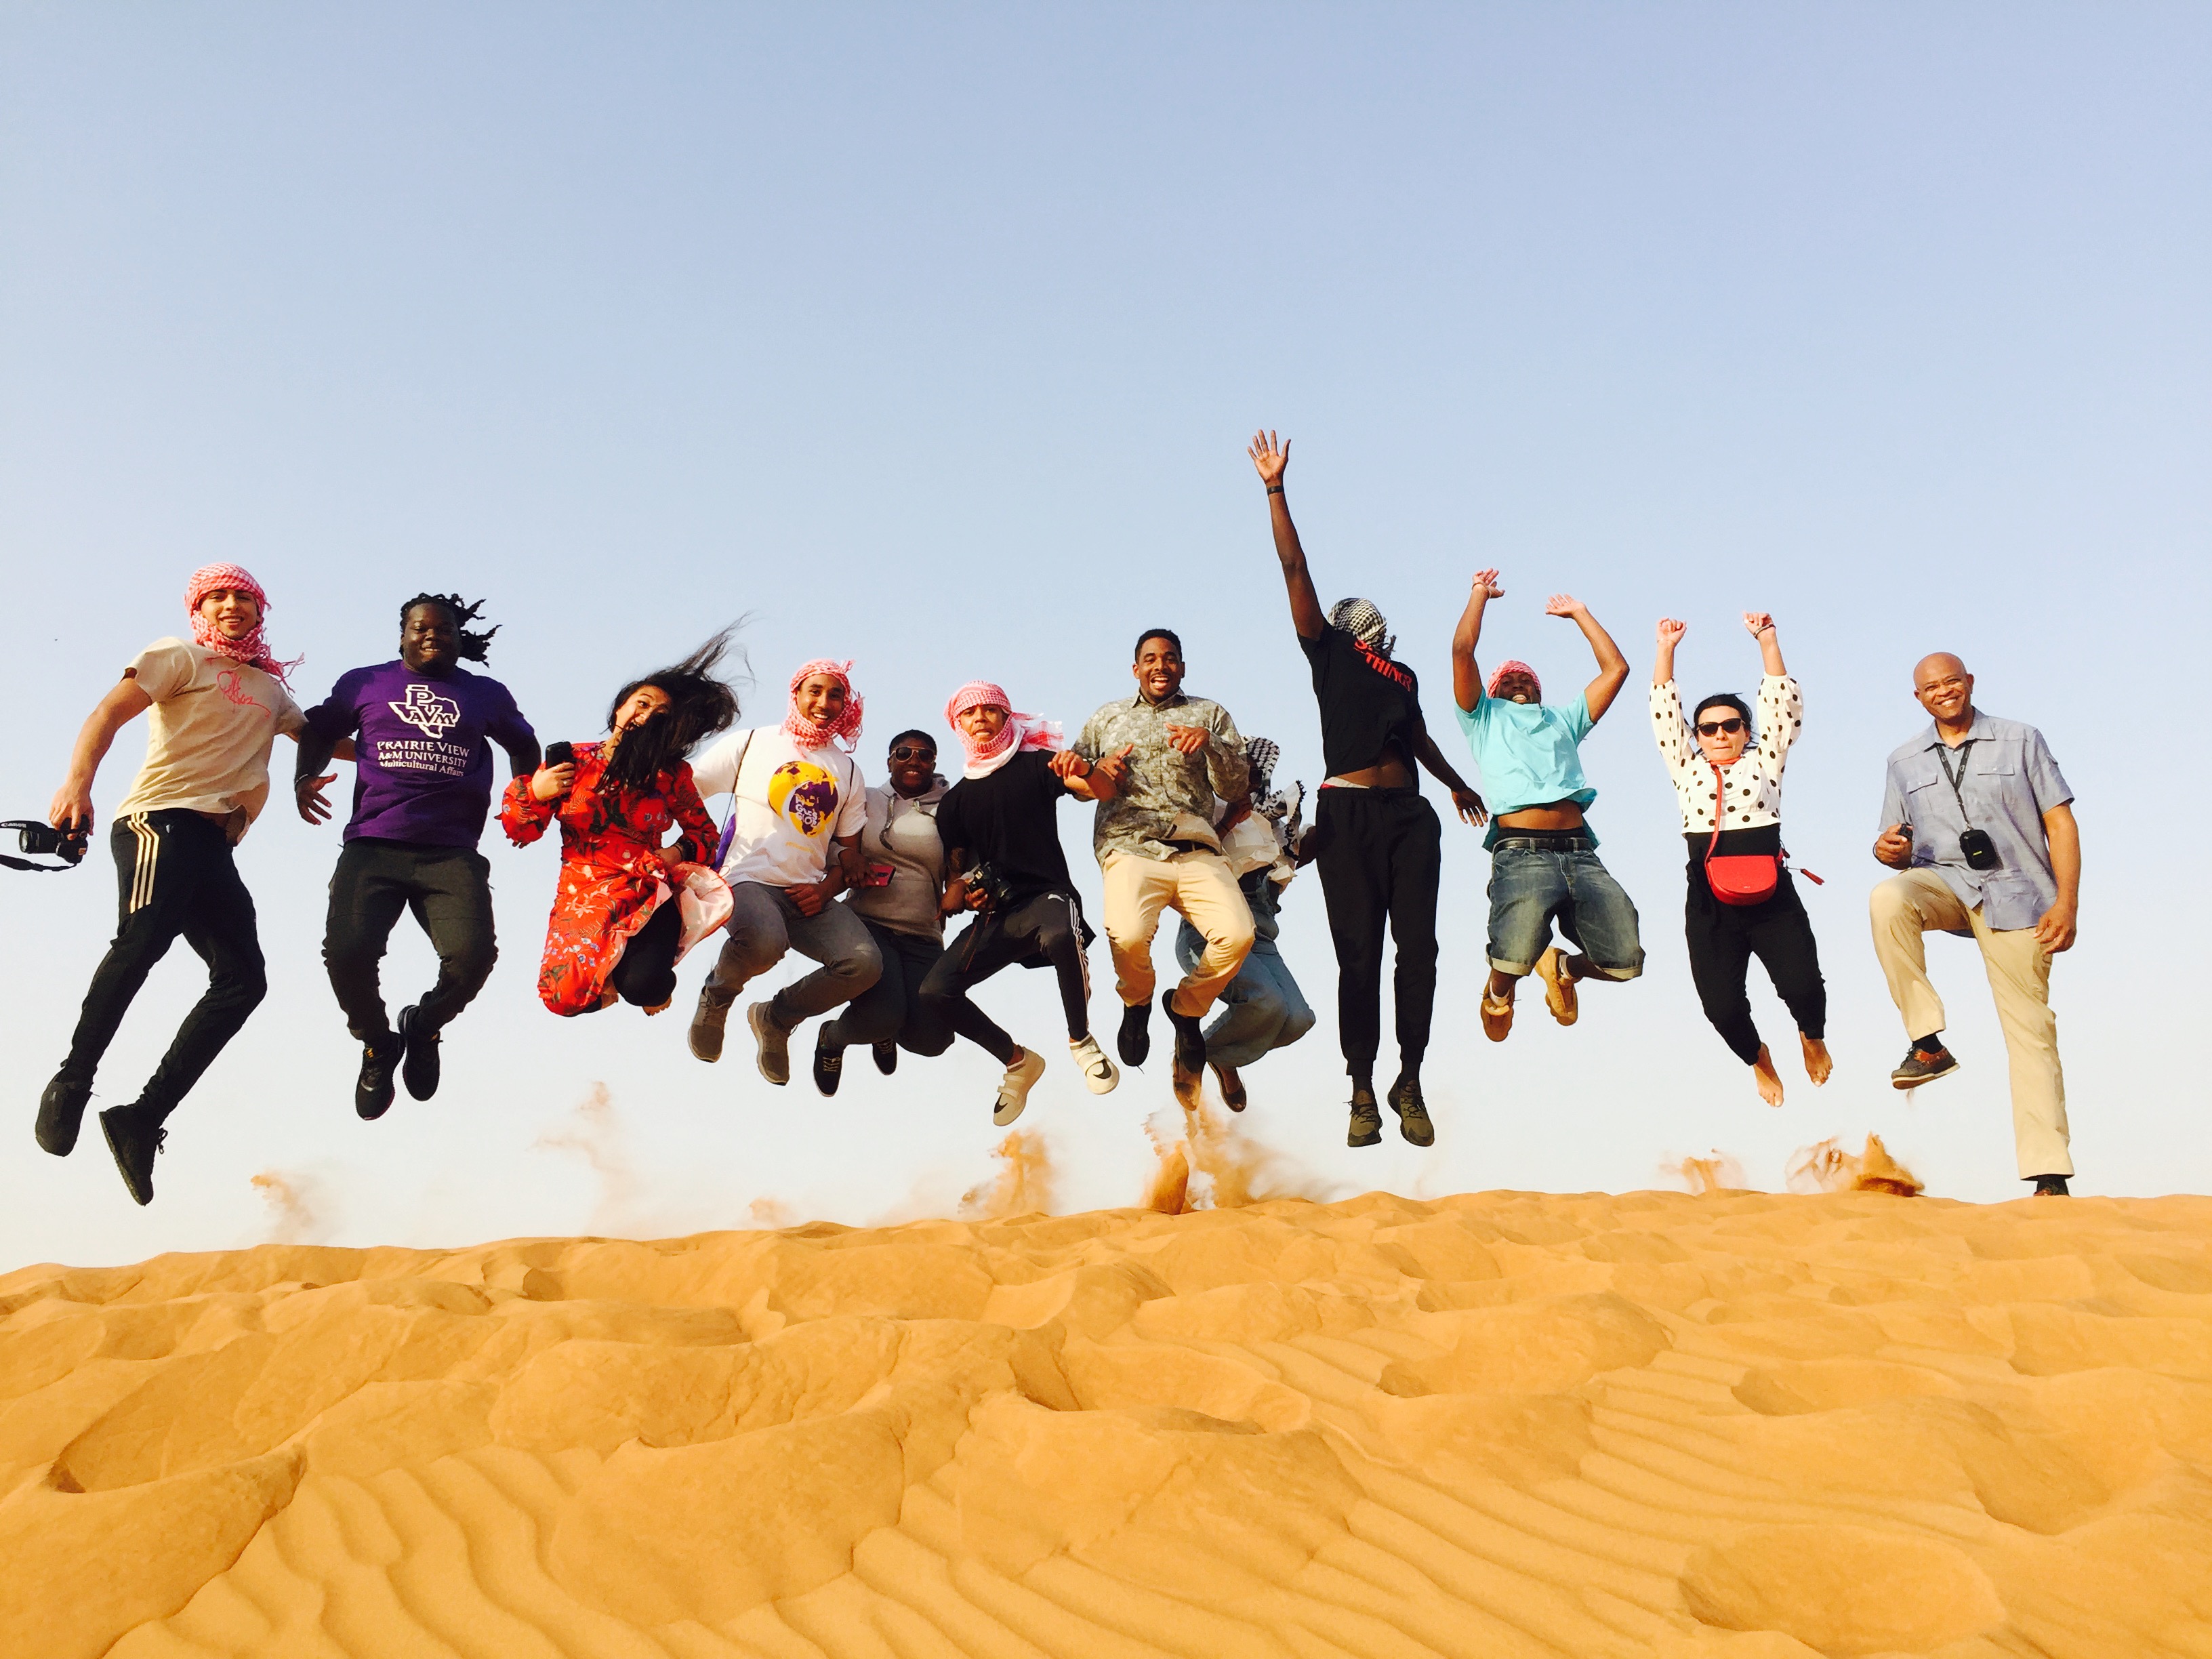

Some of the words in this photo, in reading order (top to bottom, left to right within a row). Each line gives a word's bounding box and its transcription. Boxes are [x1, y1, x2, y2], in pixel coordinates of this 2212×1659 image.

[377, 740, 434, 751] PRAIRIE
[436, 741, 470, 758] VIEW
[378, 750, 403, 760] A&M
[405, 751, 467, 768] UNIVERSITY
[380, 759, 437, 772] Multicultural
[439, 765, 464, 777] Affairs
